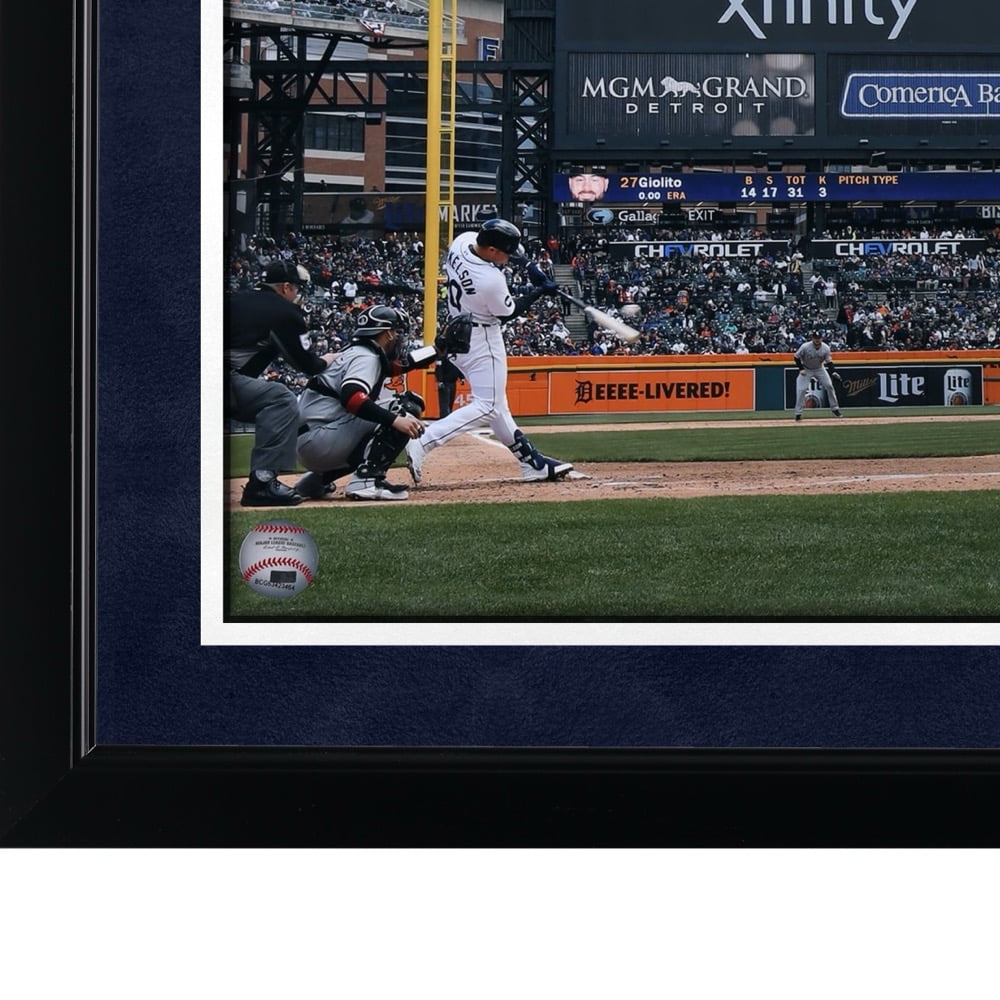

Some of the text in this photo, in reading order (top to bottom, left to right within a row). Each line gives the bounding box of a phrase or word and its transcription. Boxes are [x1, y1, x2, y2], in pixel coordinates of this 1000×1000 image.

[582, 76, 660, 98] MGM
[626, 102, 766, 114] DETROIT
[786, 176, 806, 185] TOT
[838, 175, 869, 185] PITCH
[873, 175, 898, 185] TYPE
[638, 188, 803, 200] 0.00 ERA 14 17 31
[688, 210, 715, 222] EXIT
[635, 244, 764, 258] CHEVROLET
[836, 242, 960, 256] CHEVROLET
[842, 376, 878, 397] Miller
[877, 372, 925, 404] Lite
[947, 375, 970, 391] Lite
